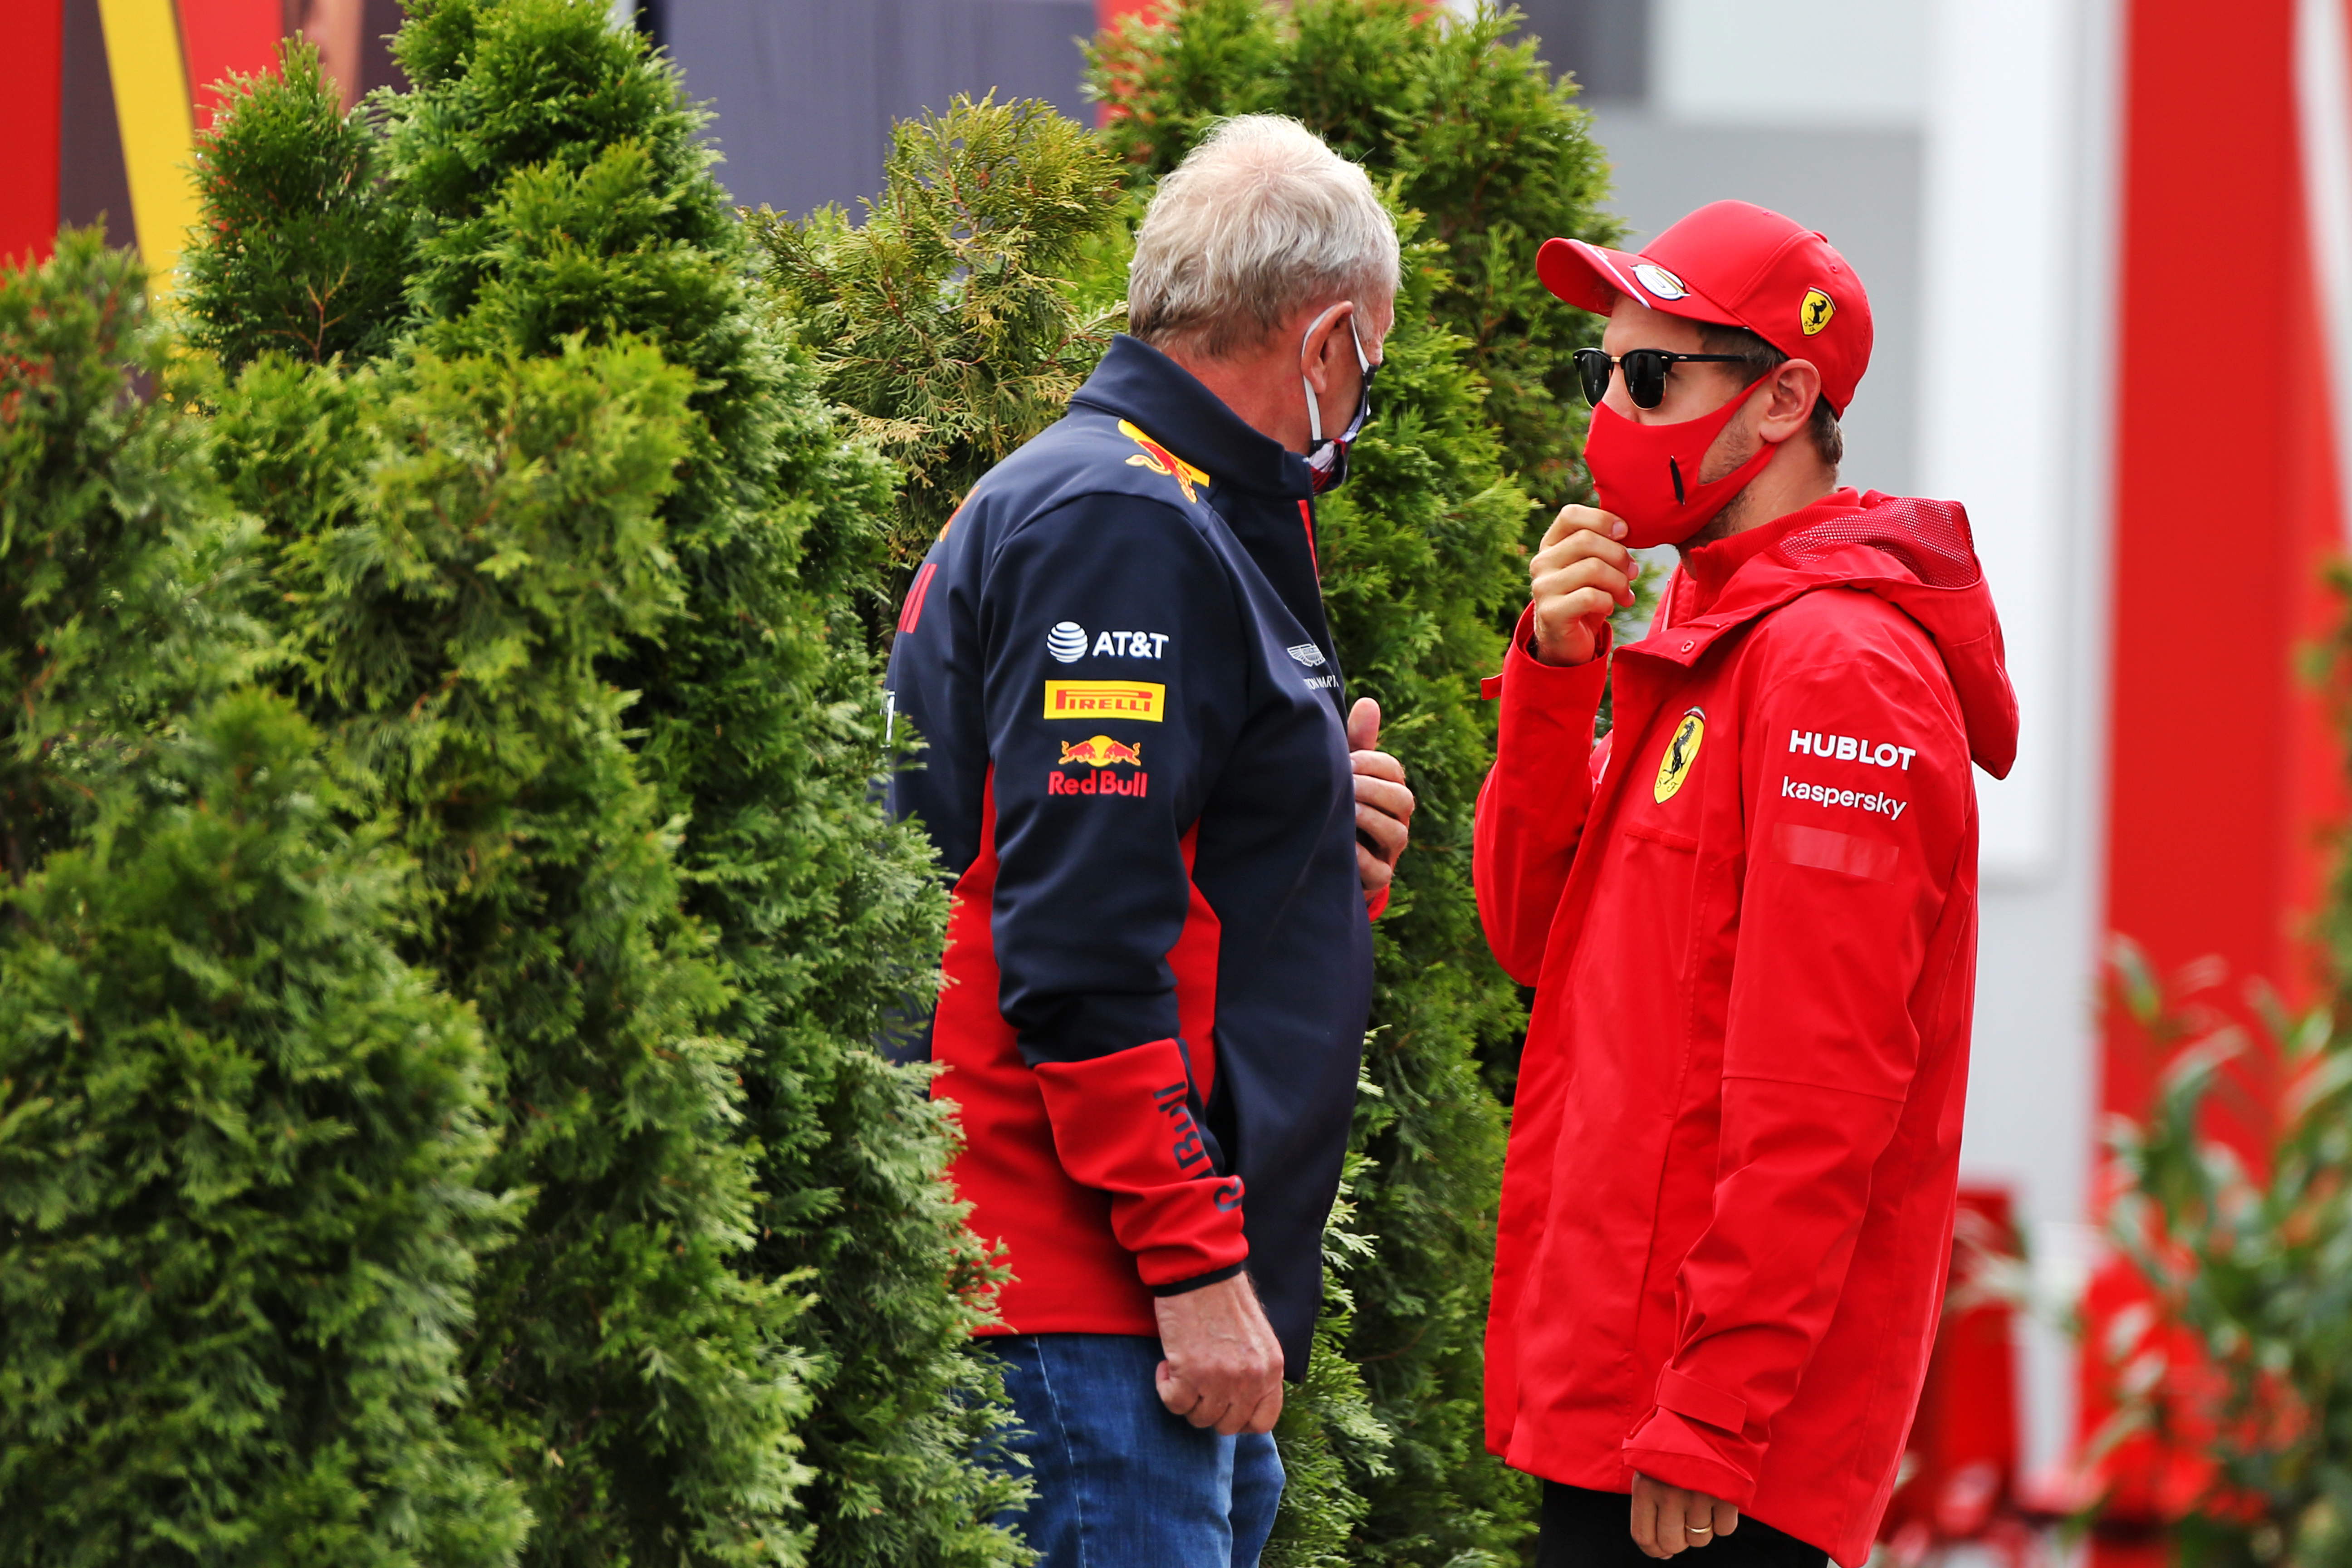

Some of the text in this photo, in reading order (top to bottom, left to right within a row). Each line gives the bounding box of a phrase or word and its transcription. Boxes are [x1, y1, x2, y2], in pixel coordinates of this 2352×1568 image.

[1092, 631, 1170, 659] AT&T
[1056, 689, 1153, 712] PIRELLI
[1788, 729, 1916, 770] HUBLOT
[1048, 769, 1148, 798] Red Bull
[1781, 776, 1907, 820] kaspersky
[1153, 1081, 1208, 1170] Bull
